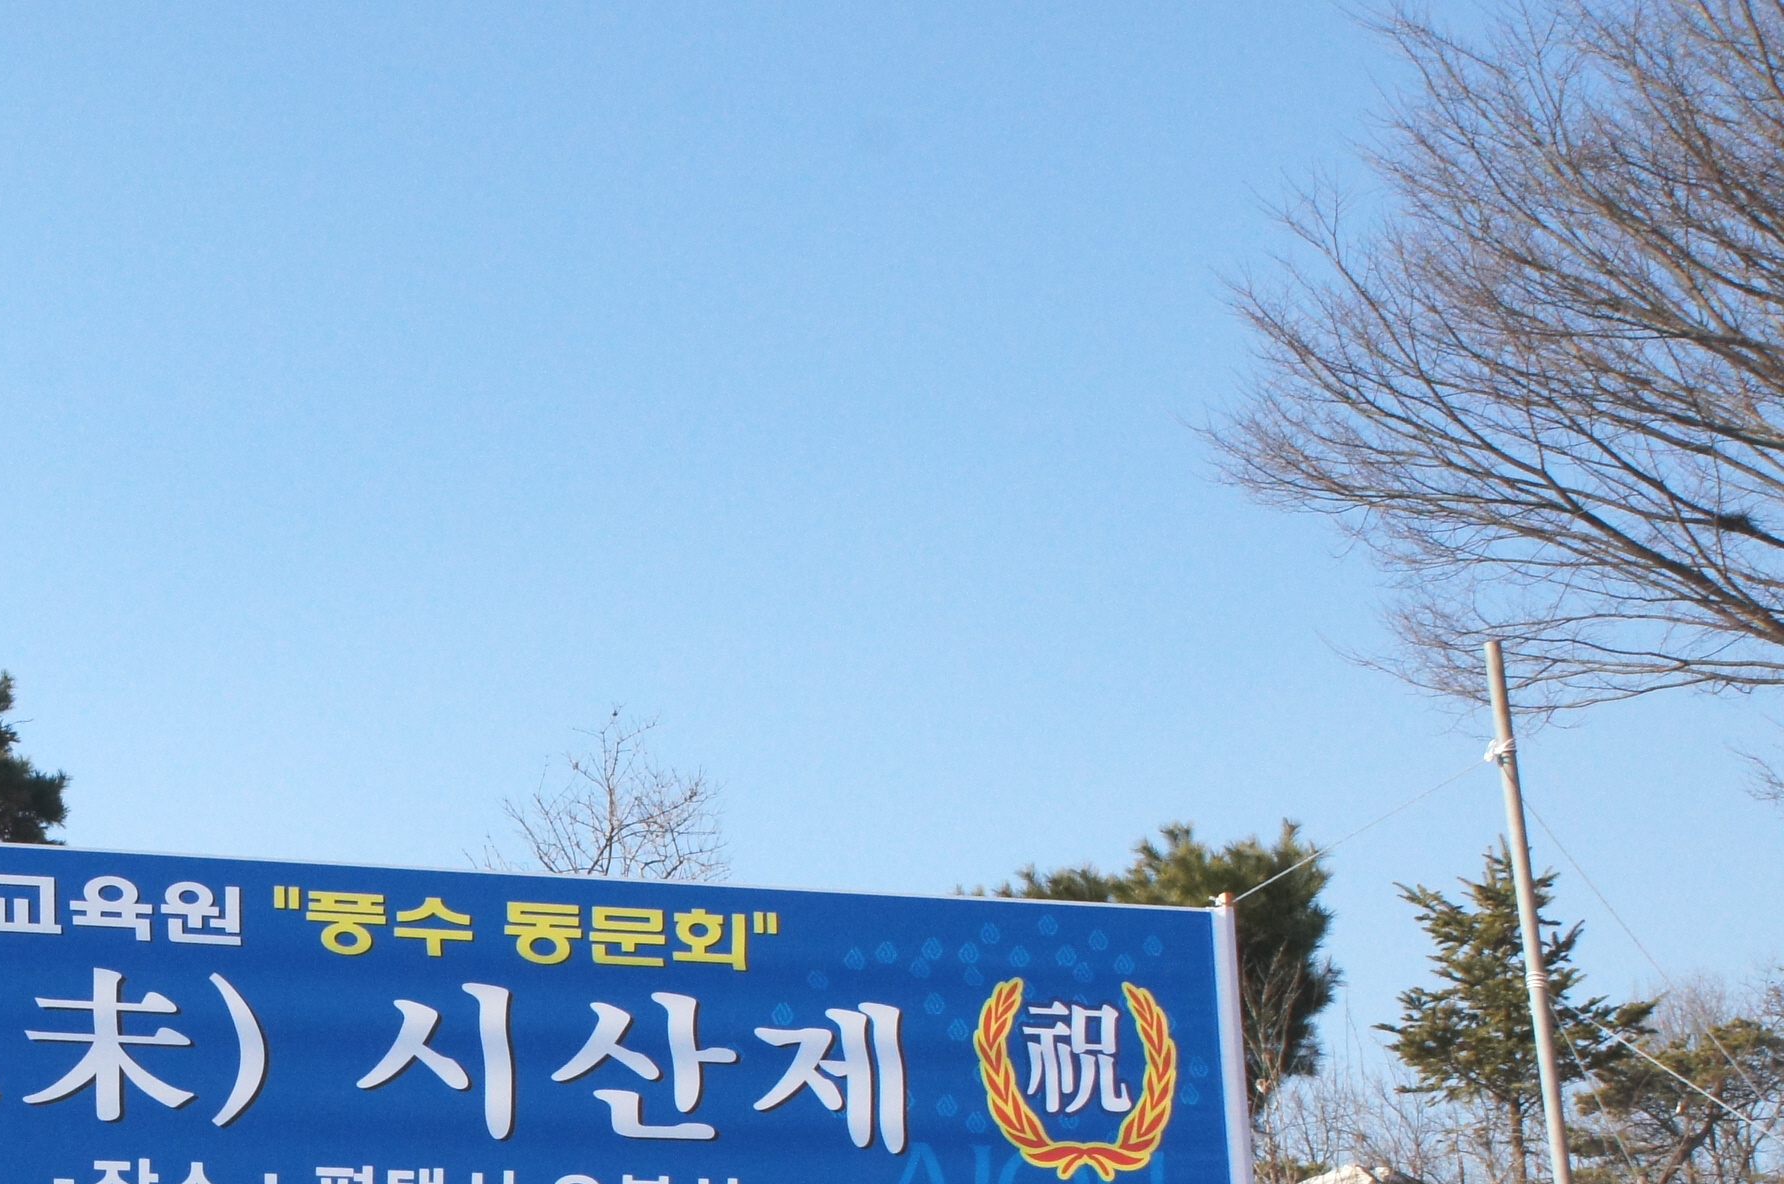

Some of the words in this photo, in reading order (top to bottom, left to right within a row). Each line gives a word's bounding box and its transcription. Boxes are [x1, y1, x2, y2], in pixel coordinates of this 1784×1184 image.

[273, 884, 474, 956] "풍수
[504, 900, 778, 971] 동문회"
[356, 982, 905, 1154] 시산제
[1022, 1001, 1132, 1114] 祝
